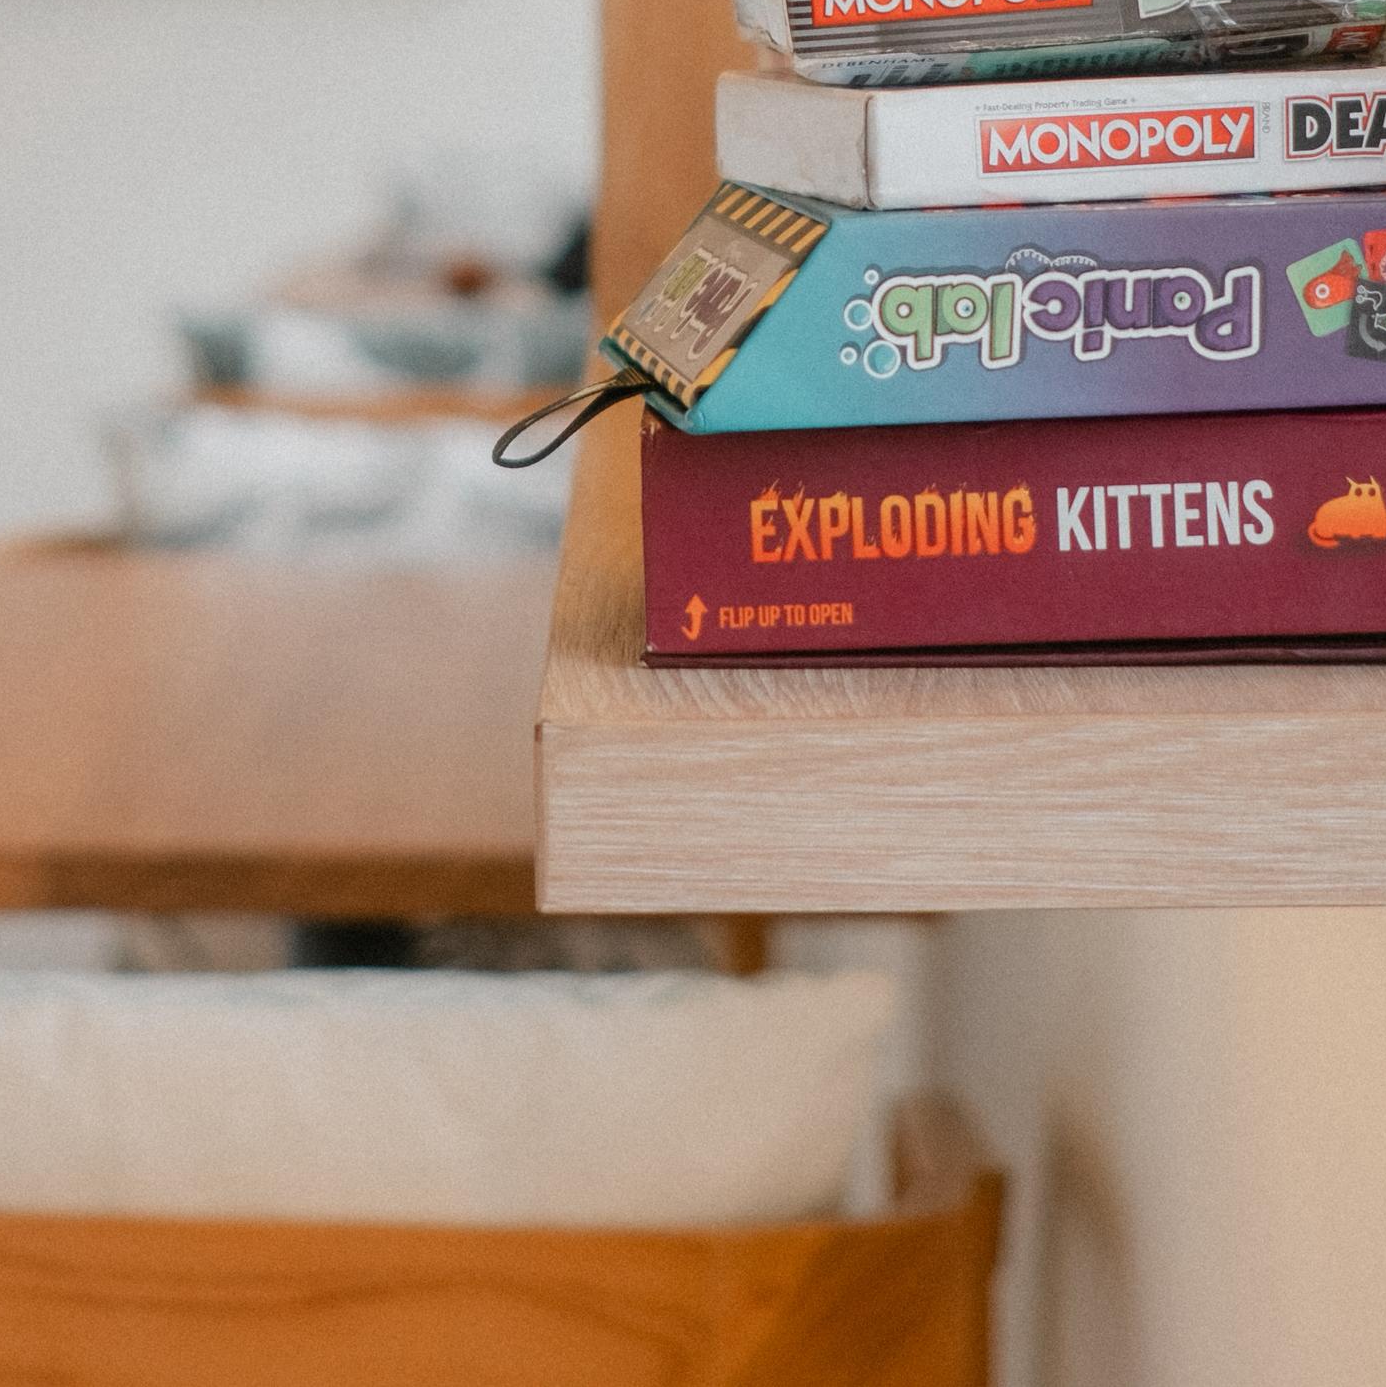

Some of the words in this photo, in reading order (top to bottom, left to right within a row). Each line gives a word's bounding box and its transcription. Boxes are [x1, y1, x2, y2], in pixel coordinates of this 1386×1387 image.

[983, 101, 1033, 113] Fast-Dealing
[1035, 99, 1070, 111] Property
[1071, 98, 1102, 110] Trading
[1103, 96, 1128, 107] Game
[988, 112, 1251, 166] MONOPOLY
[873, 274, 1022, 369] lab
[1023, 267, 1261, 361] Panic
[749, 481, 1037, 563] EXPLODING
[1056, 479, 1275, 552] KITTENS
[719, 605, 755, 629] FLIP
[758, 604, 783, 627] UP
[784, 603, 806, 626] TO
[809, 602, 854, 626] OPEN
